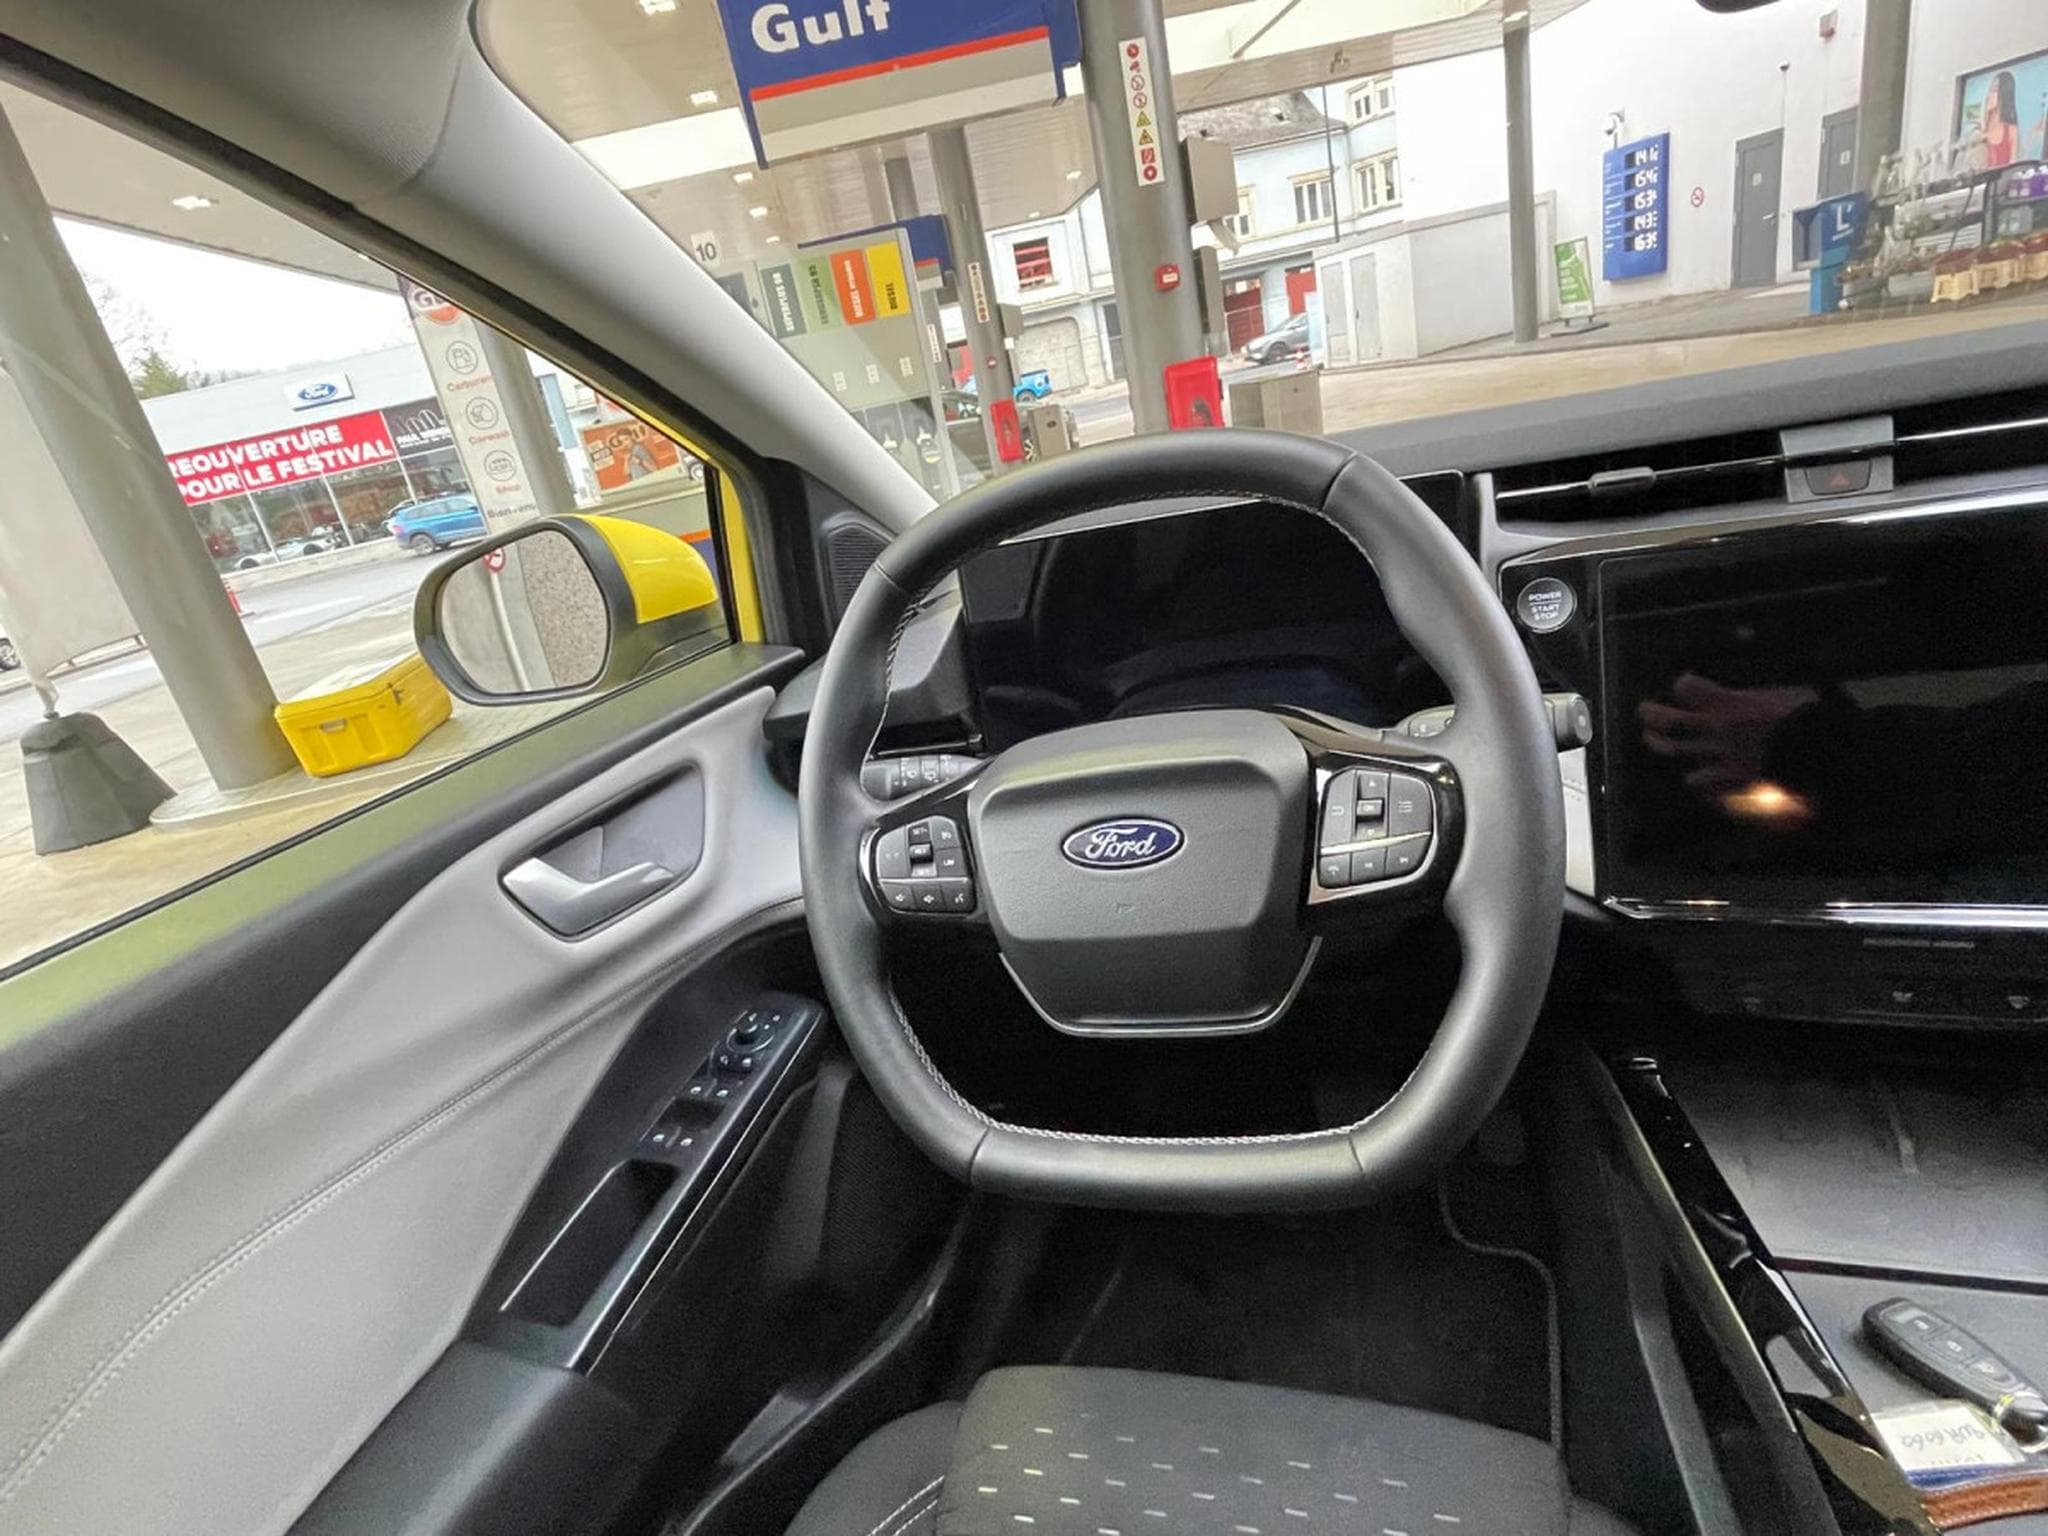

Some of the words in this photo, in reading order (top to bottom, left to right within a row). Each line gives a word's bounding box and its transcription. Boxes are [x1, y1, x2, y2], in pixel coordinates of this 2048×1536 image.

[751, 0, 890, 53] Gulf
[696, 242, 717, 261] 10
[884, 281, 898, 311] DIESEL
[245, 464, 276, 486] LE
[277, 440, 394, 478] FESTIVAL
[1529, 590, 1562, 601] POWER
[1531, 603, 1560, 613] START
[1534, 611, 1559, 620] STOP
[1085, 827, 1157, 859] Ford
